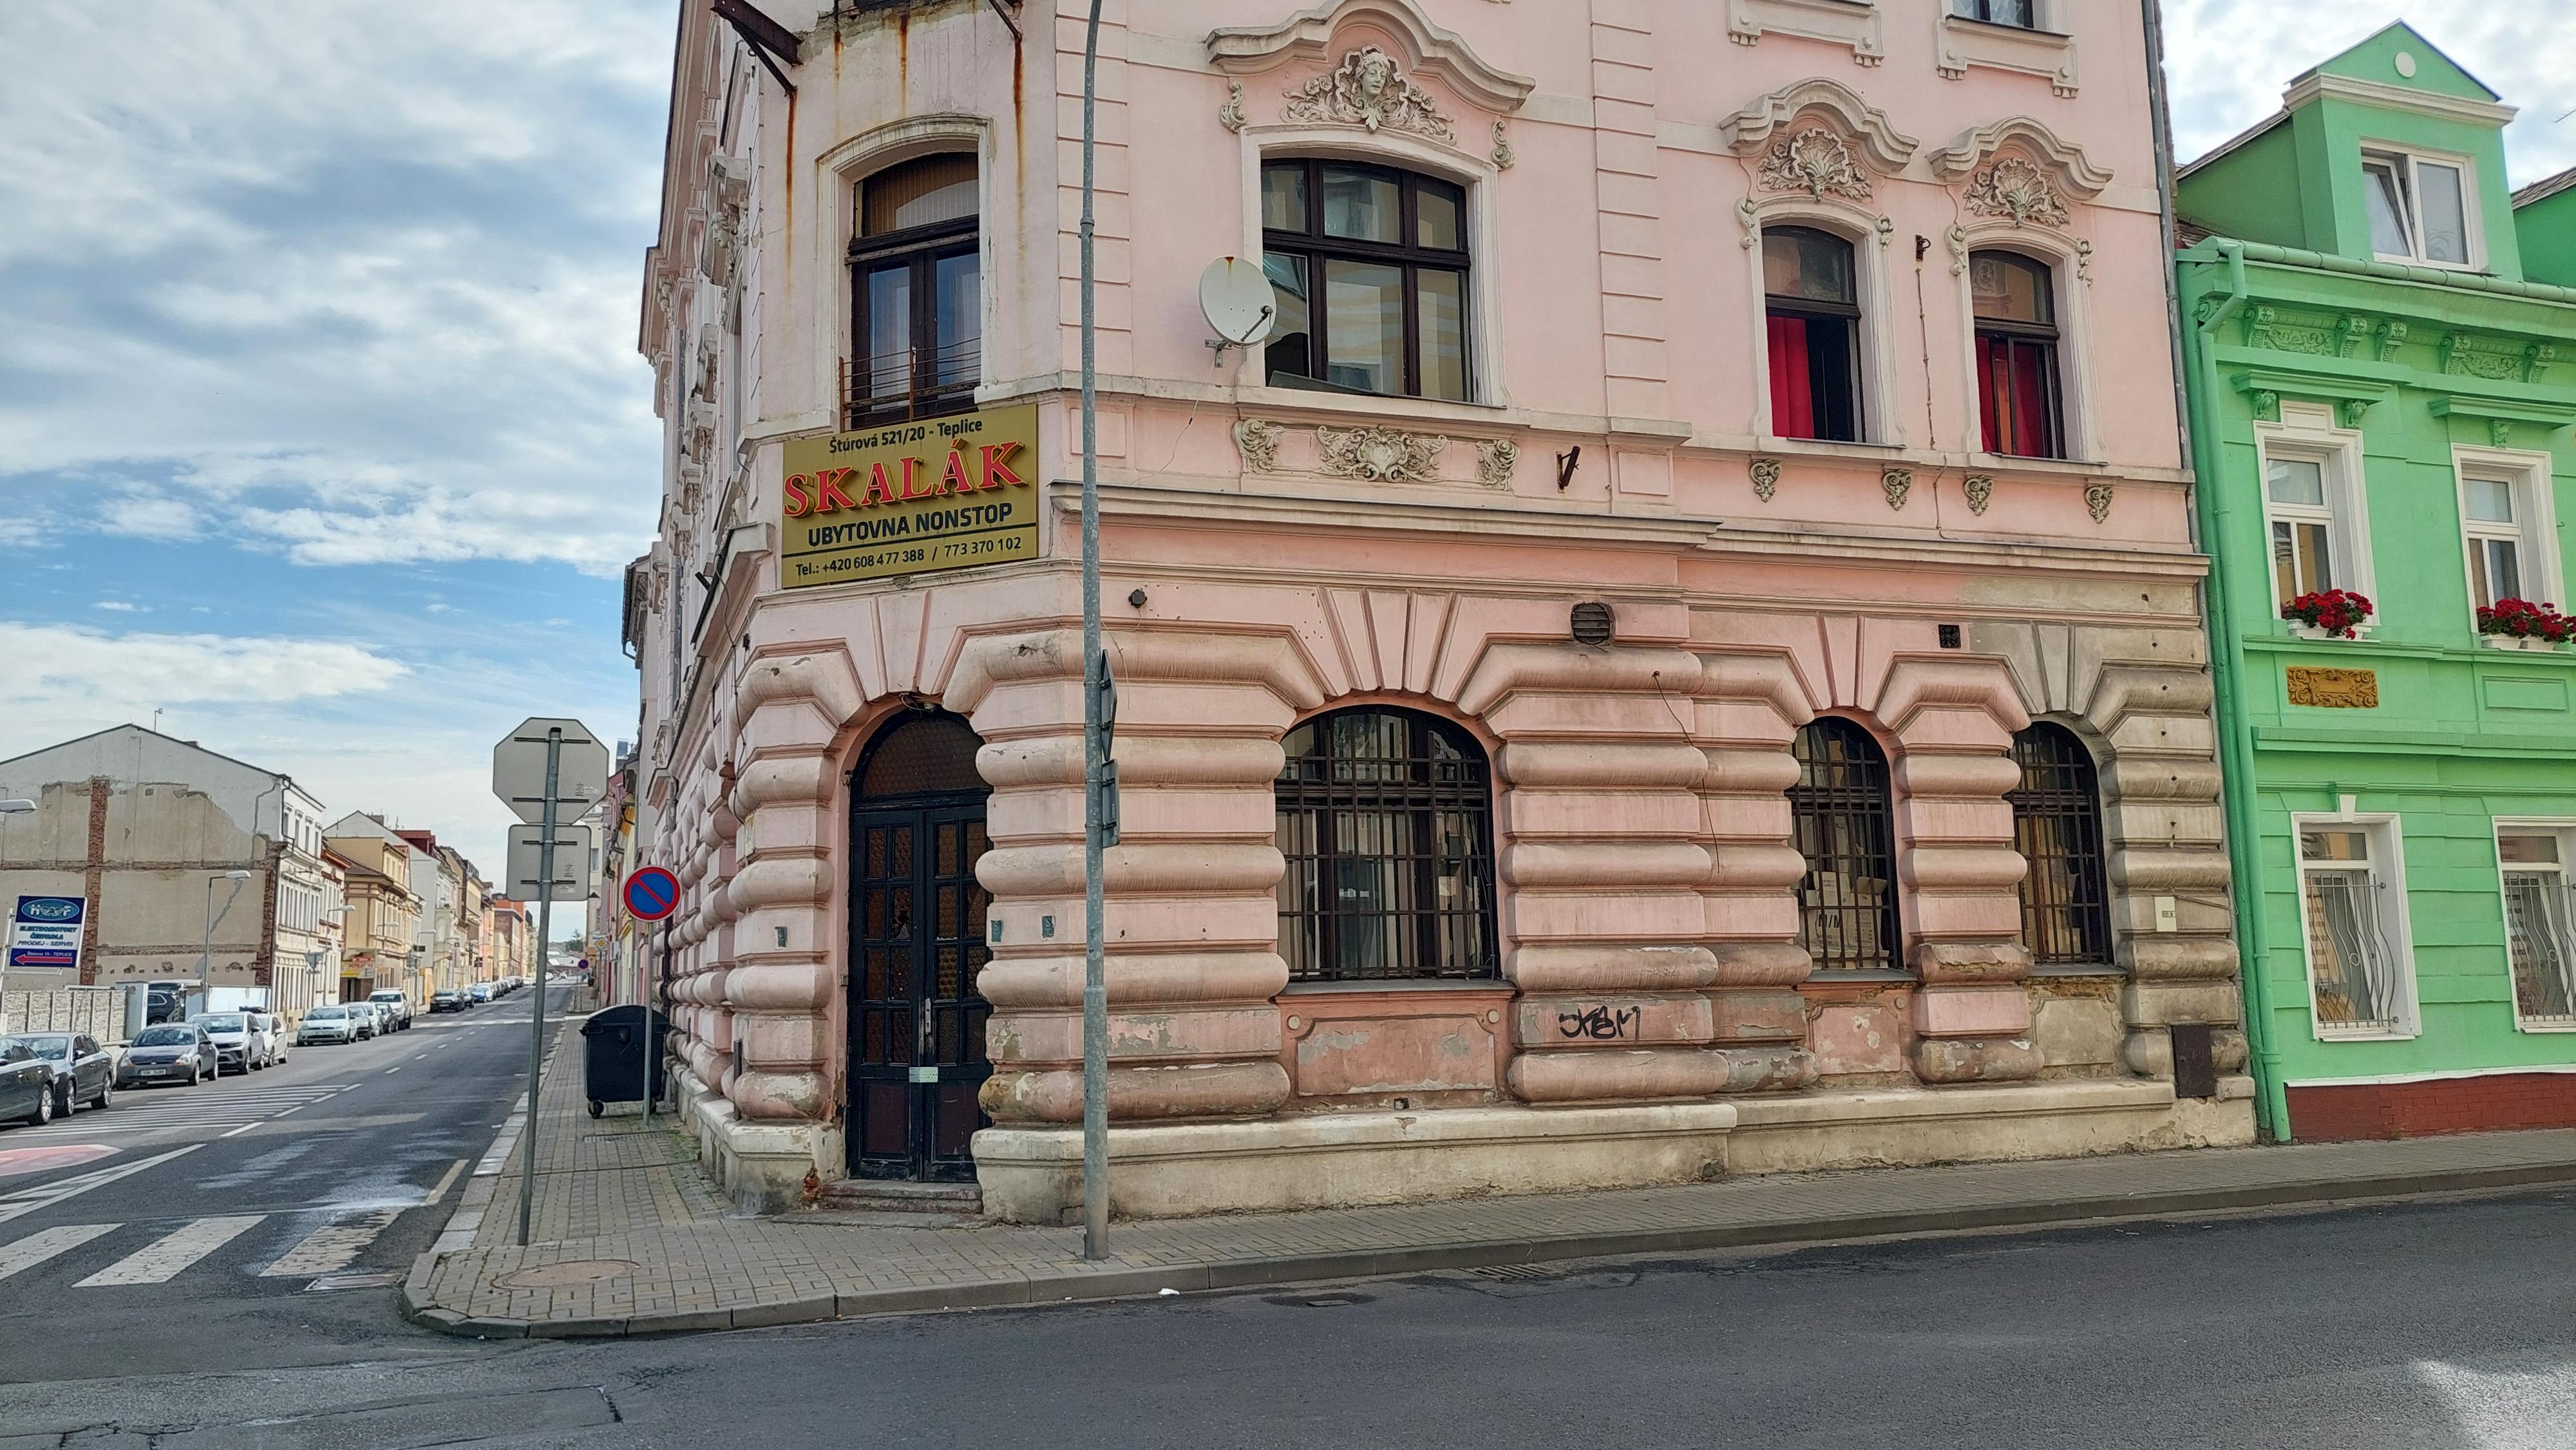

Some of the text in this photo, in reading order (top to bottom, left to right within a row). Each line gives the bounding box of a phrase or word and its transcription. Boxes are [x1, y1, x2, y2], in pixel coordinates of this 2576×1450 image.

[829, 434, 878, 453] Štúrová
[882, 426, 925, 446] 521/20
[937, 419, 983, 438] Teplice
[784, 438, 1025, 518] SKALÁK
[808, 503, 1012, 547] UBYTOVNA NONSTOP
[795, 537, 1021, 576] Tel.: +420 608 477 388 / 773 370 102
